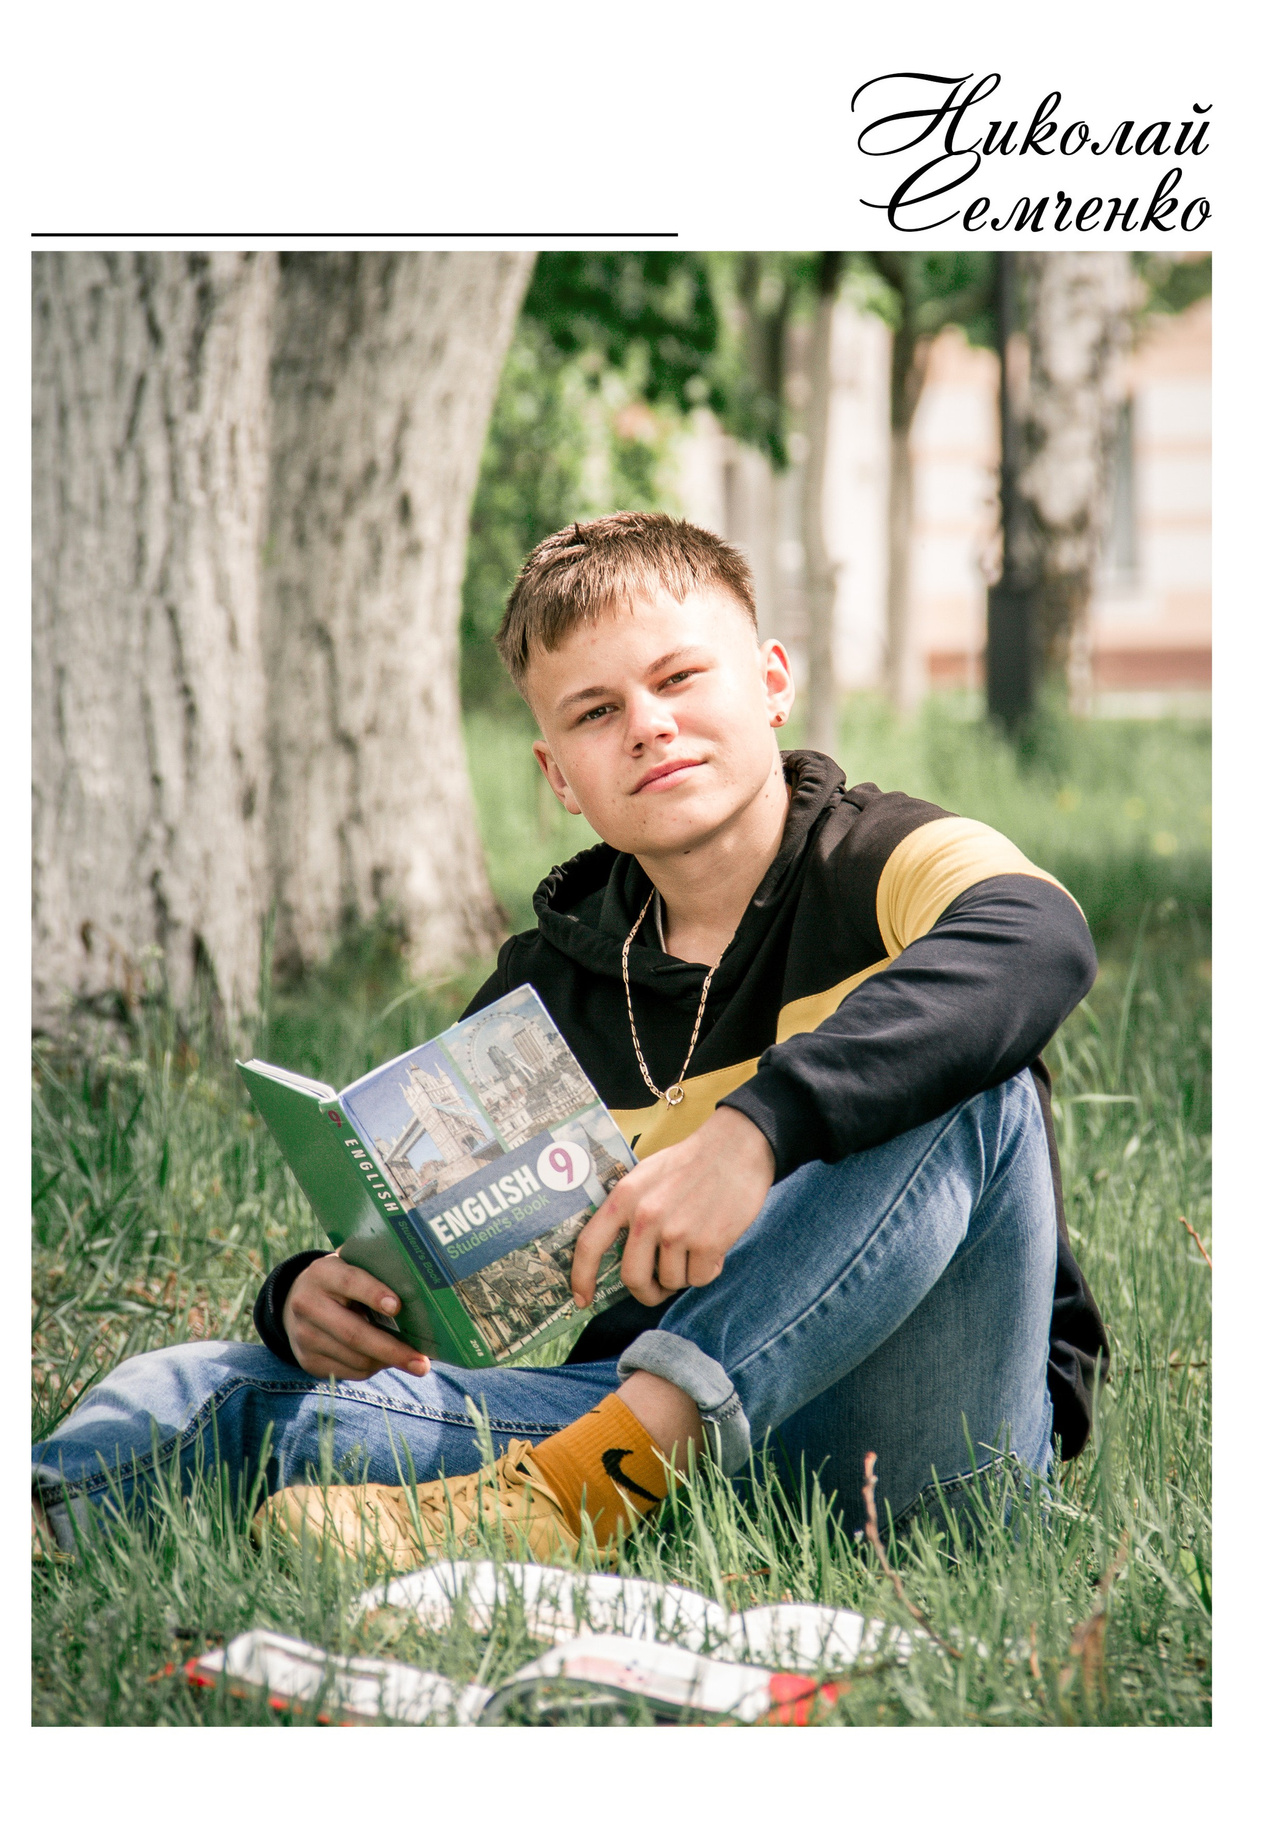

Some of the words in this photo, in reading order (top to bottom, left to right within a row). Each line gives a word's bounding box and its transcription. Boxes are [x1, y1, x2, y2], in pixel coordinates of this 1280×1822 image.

[327, 1109, 342, 1128] 9
[344, 1138, 399, 1212] ENGLISH
[427, 1164, 541, 1247] ENGLISH
[548, 1147, 574, 1185] 9
[398, 1220, 426, 1260] Student's
[422, 1261, 441, 1285] Book
[446, 1216, 513, 1260] Student's
[511, 1193, 551, 1222] Book
[606, 1279, 625, 1295] insid
